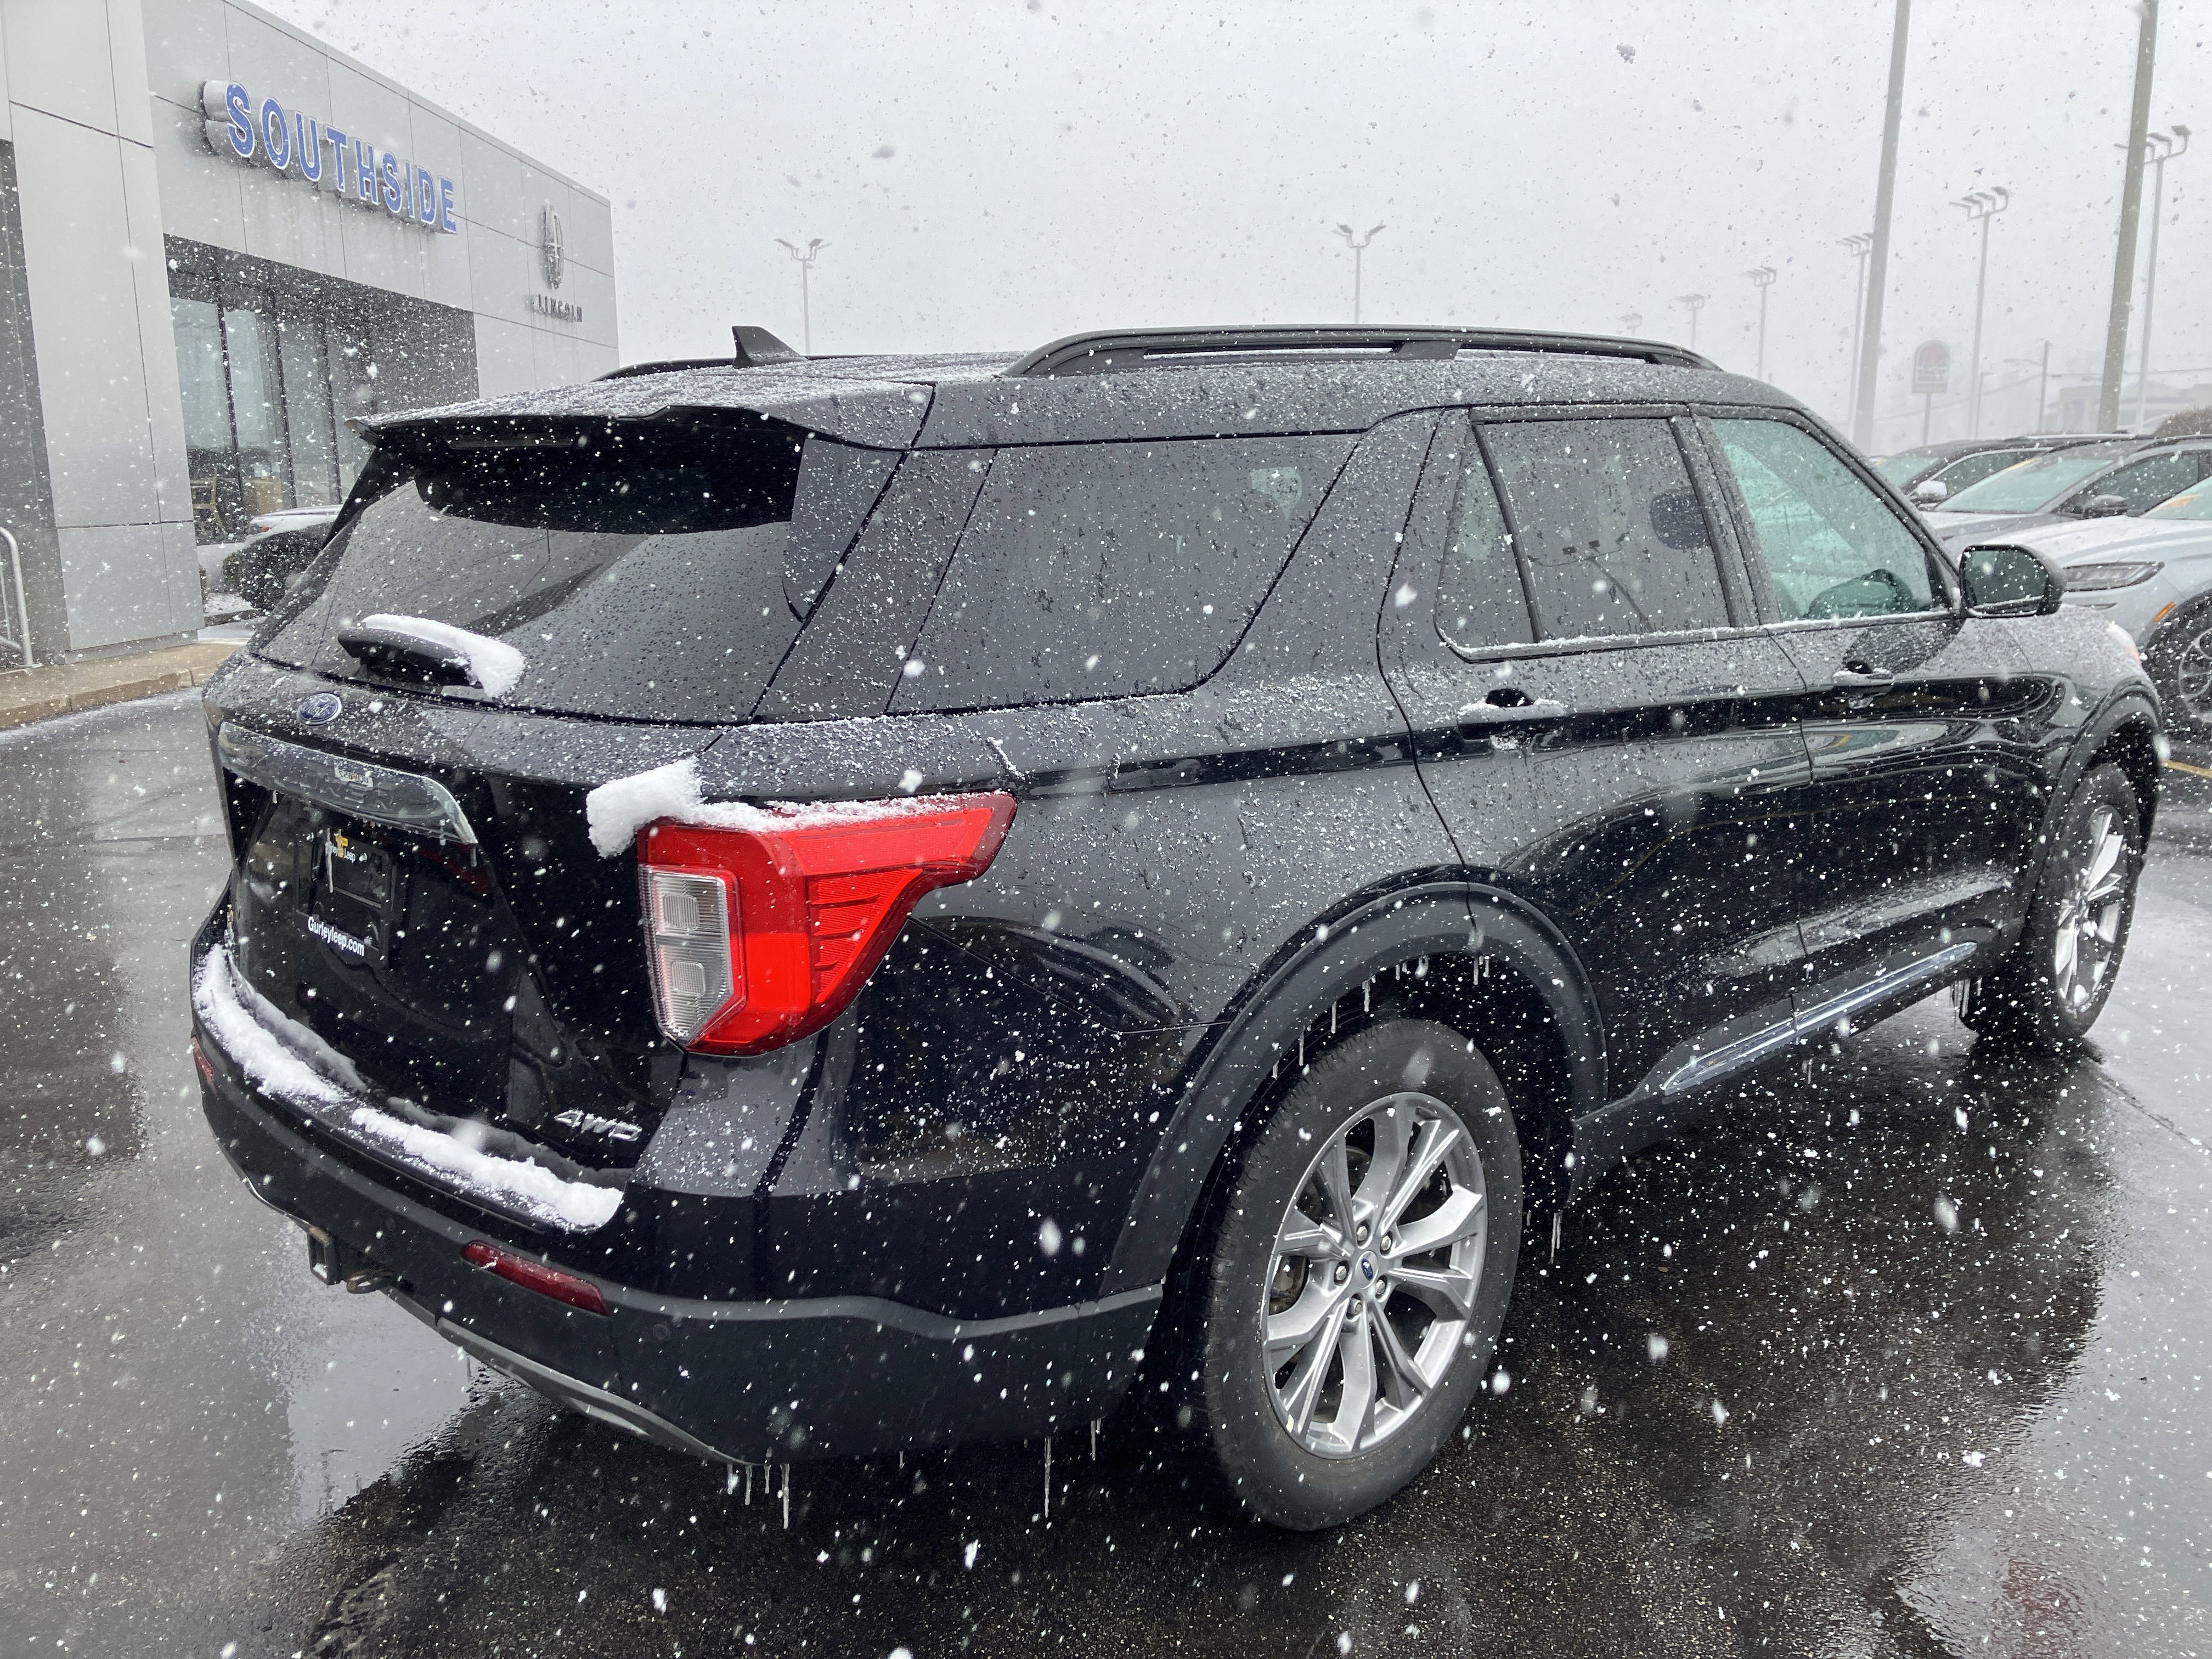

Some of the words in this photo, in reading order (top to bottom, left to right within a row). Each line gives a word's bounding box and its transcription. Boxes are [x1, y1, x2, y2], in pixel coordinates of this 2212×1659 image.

[225, 82, 457, 234] SOUTHSIDE
[308, 916, 365, 957] Gurleyleep.com
[554, 1106, 643, 1141] 4WD
